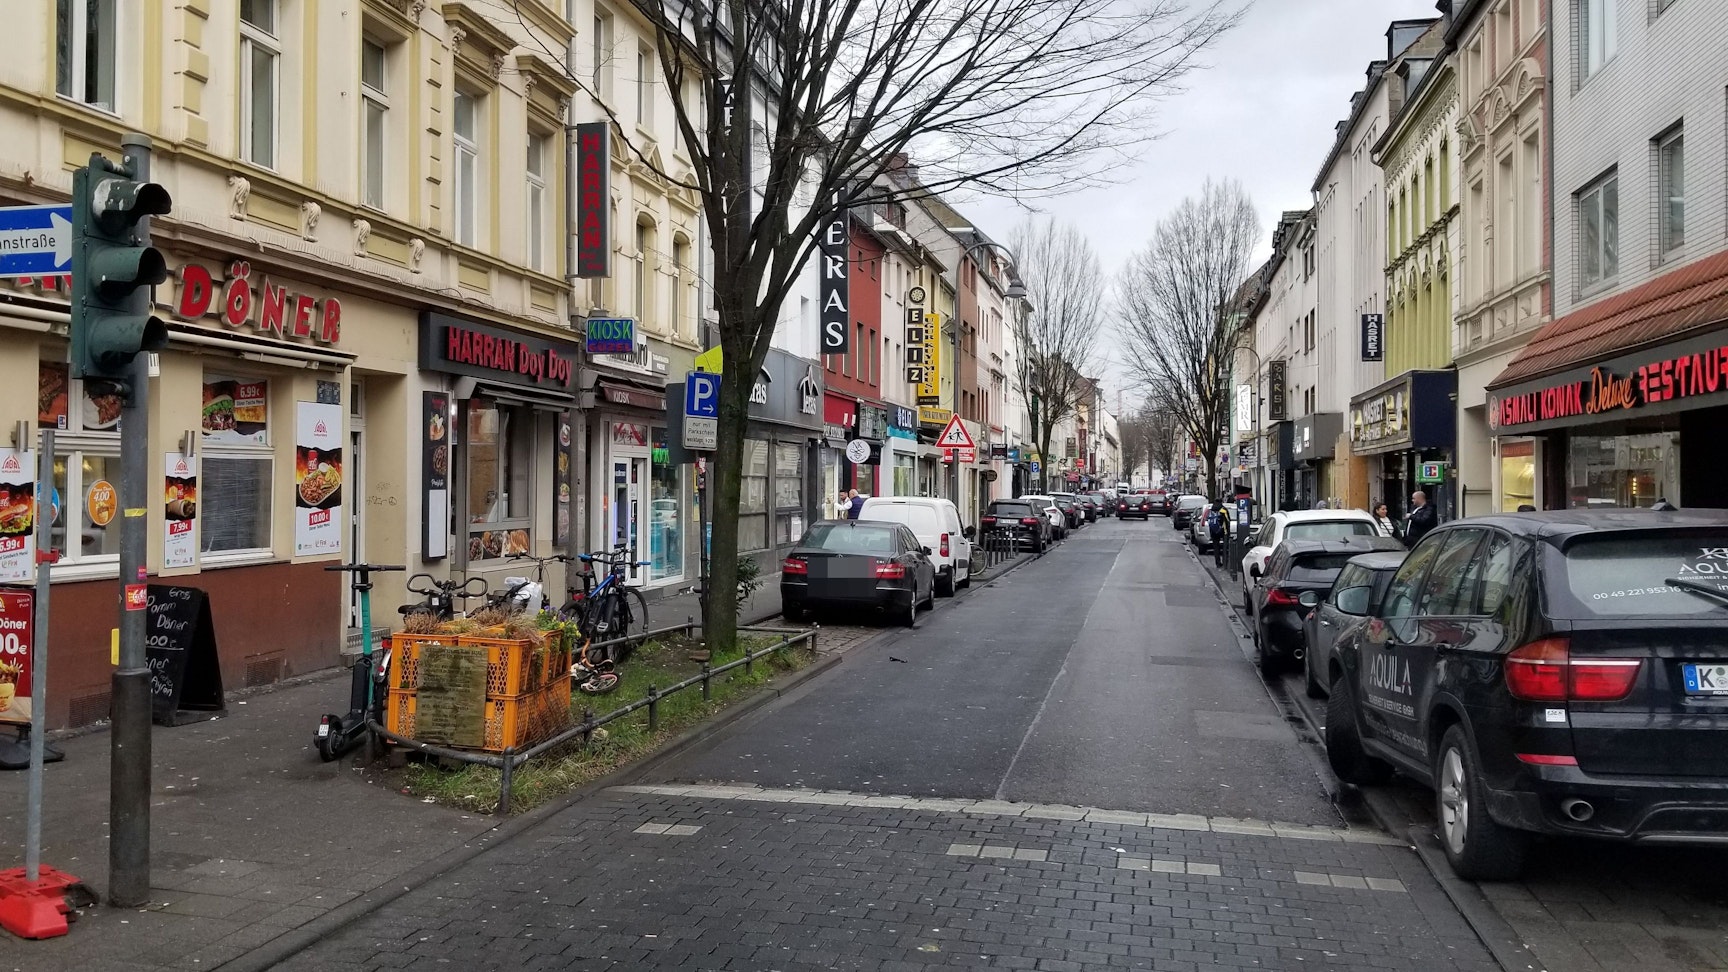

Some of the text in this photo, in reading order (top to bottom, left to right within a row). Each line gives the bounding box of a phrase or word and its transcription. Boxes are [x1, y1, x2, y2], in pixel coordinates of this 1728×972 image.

[582, 133, 601, 249] HARRAN
[180, 260, 341, 345] DÖNER
[588, 321, 632, 340] KIOSK
[911, 310, 919, 382] ELIZ
[1367, 315, 1378, 357] HASRET
[448, 325, 516, 372] HARRAN
[519, 343, 545, 384] Doy
[549, 348, 573, 387] Doy
[614, 392, 630, 404] KIOSK
[694, 378, 713, 411] P
[1499, 390, 1537, 426] ASMALI
[1541, 381, 1583, 418] KONAK
[1586, 366, 1637, 416] Deluxe
[1240, 499, 1245, 507] P
[1628, 588, 1645, 596] 221
[1369, 653, 1413, 696] AQUILA
[1699, 668, 1715, 688] K
